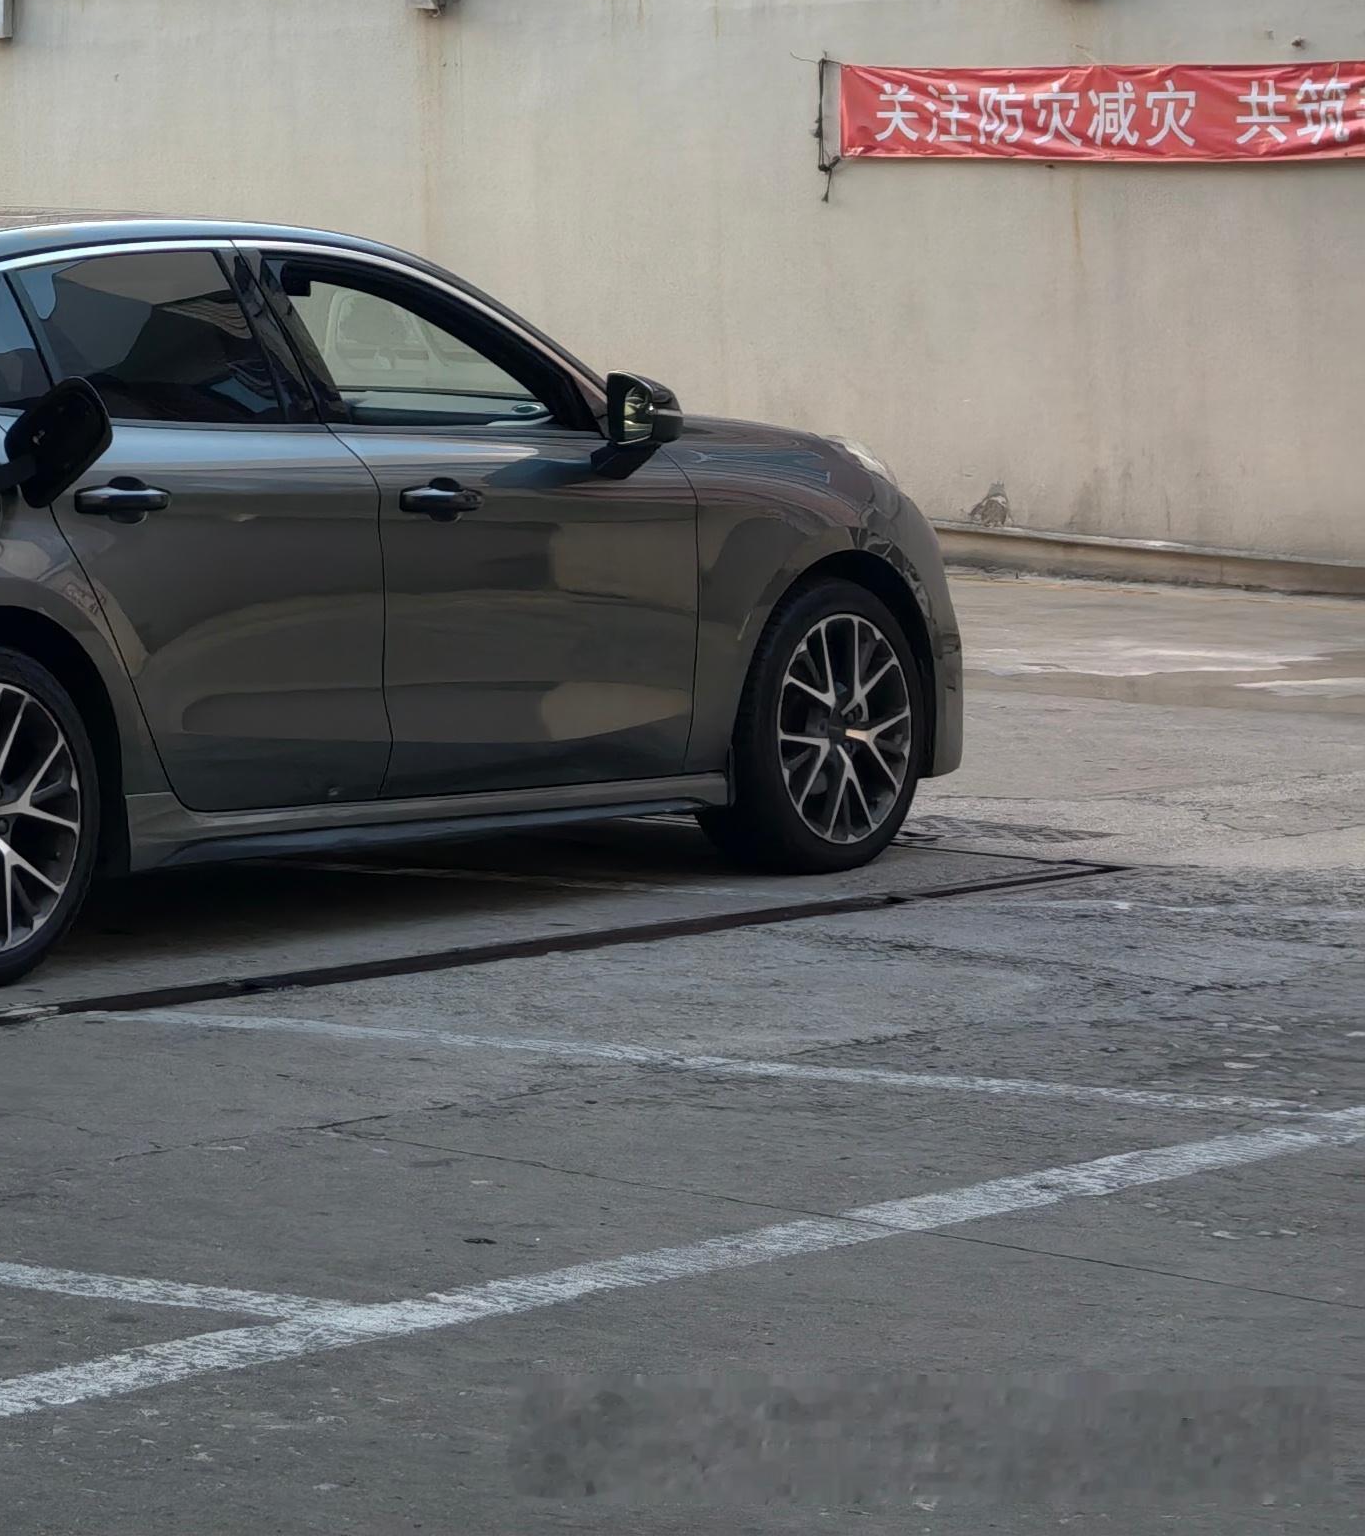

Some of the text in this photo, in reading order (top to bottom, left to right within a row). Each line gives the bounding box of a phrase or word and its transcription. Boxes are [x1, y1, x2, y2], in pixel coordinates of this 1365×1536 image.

[875, 78, 1365, 146] 关注防灾减灾 共筑
